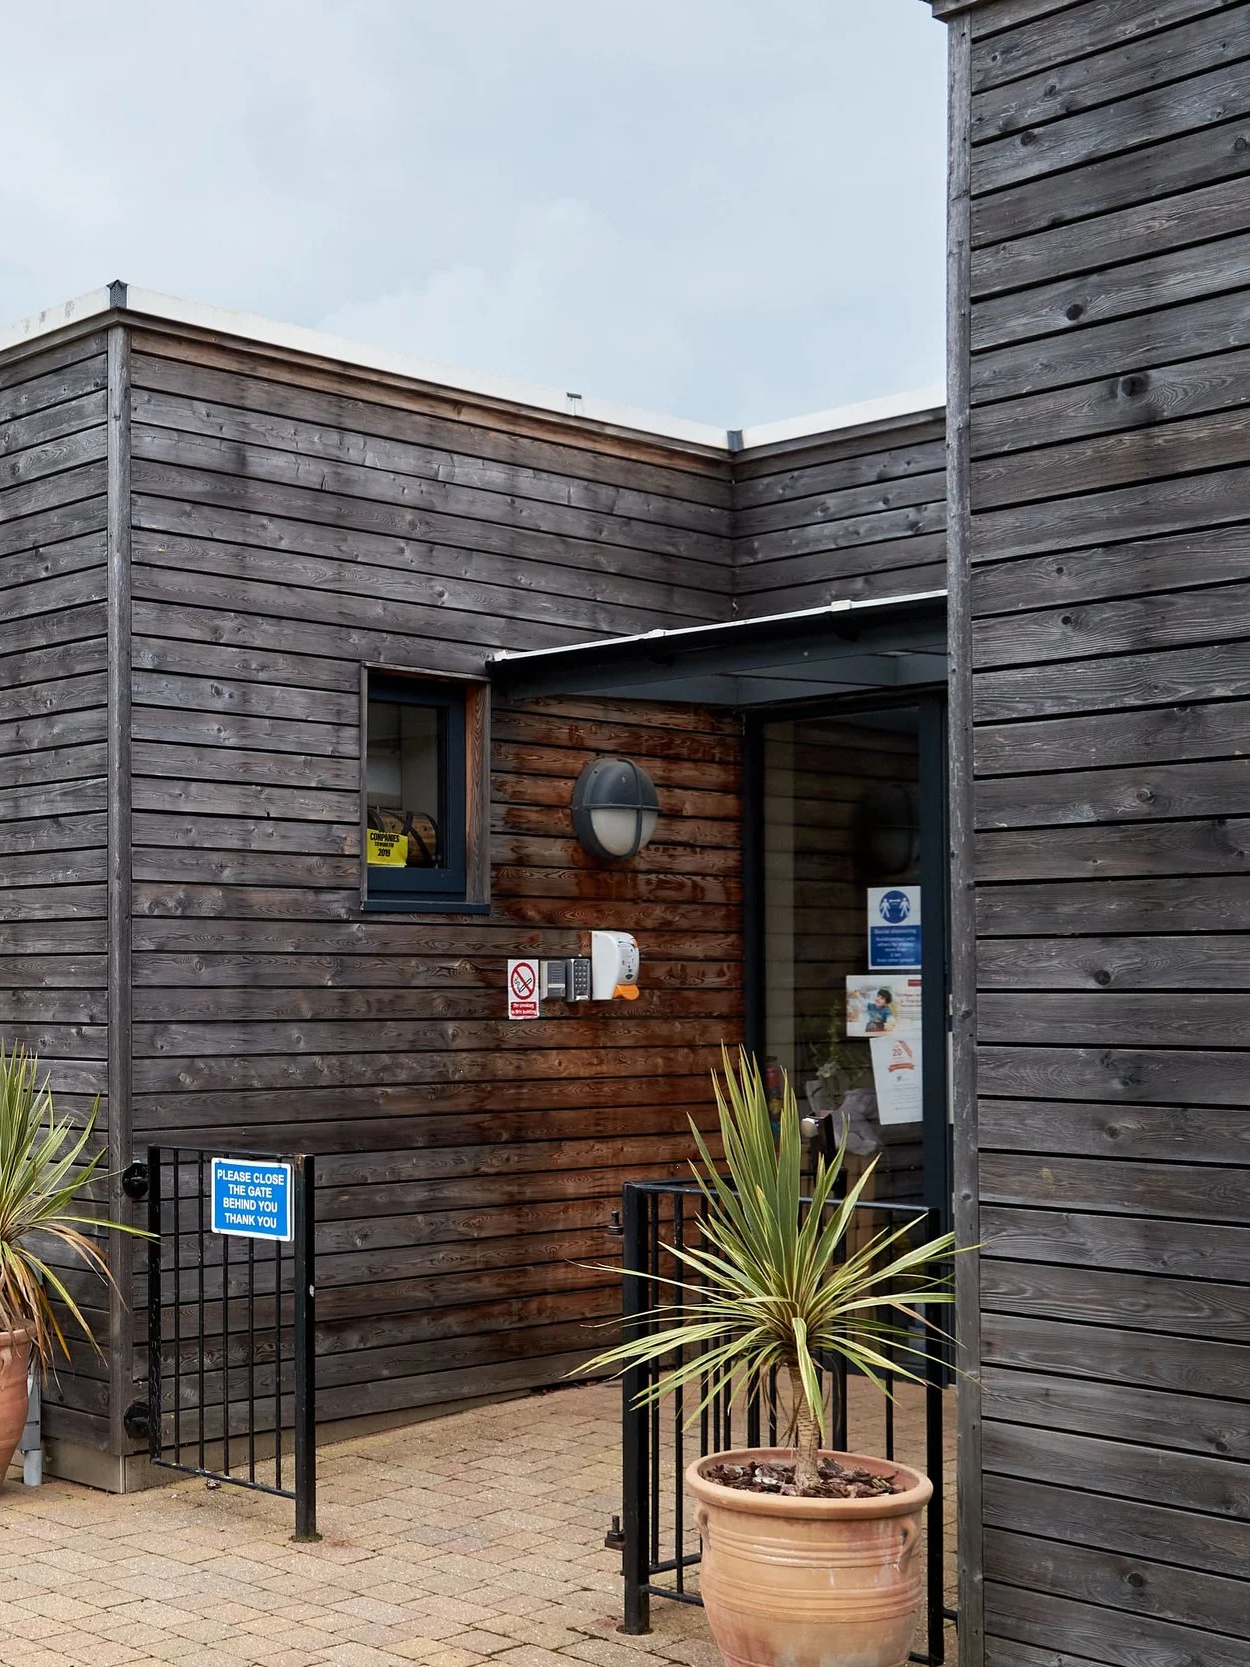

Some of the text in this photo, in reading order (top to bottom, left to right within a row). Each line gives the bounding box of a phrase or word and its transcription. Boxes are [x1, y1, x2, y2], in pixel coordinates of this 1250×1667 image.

[370, 832, 399, 842] COMPANIES
[217, 1169, 285, 1185] PLEASE CLOSE
[228, 1184, 272, 1198] THE GATE
[223, 1197, 278, 1213] BEHIND YOU
[224, 1213, 277, 1228] THANK YOU
